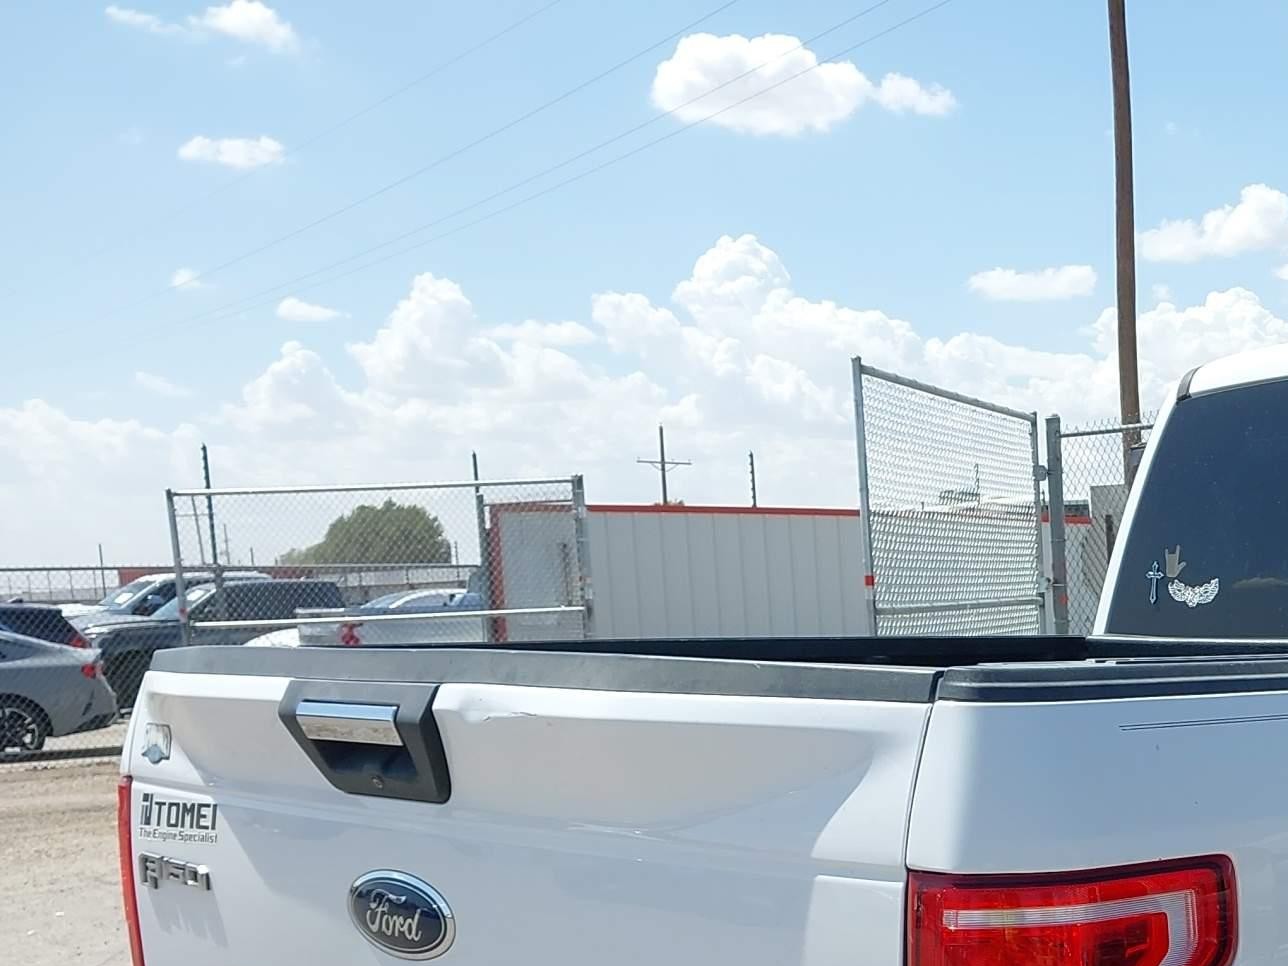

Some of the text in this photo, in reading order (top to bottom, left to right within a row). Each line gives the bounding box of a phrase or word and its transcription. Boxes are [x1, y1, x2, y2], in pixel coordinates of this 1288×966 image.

[154, 801, 218, 830] TOMEI
[139, 828, 217, 843] The Engine Specialist
[366, 888, 422, 941] Ford
